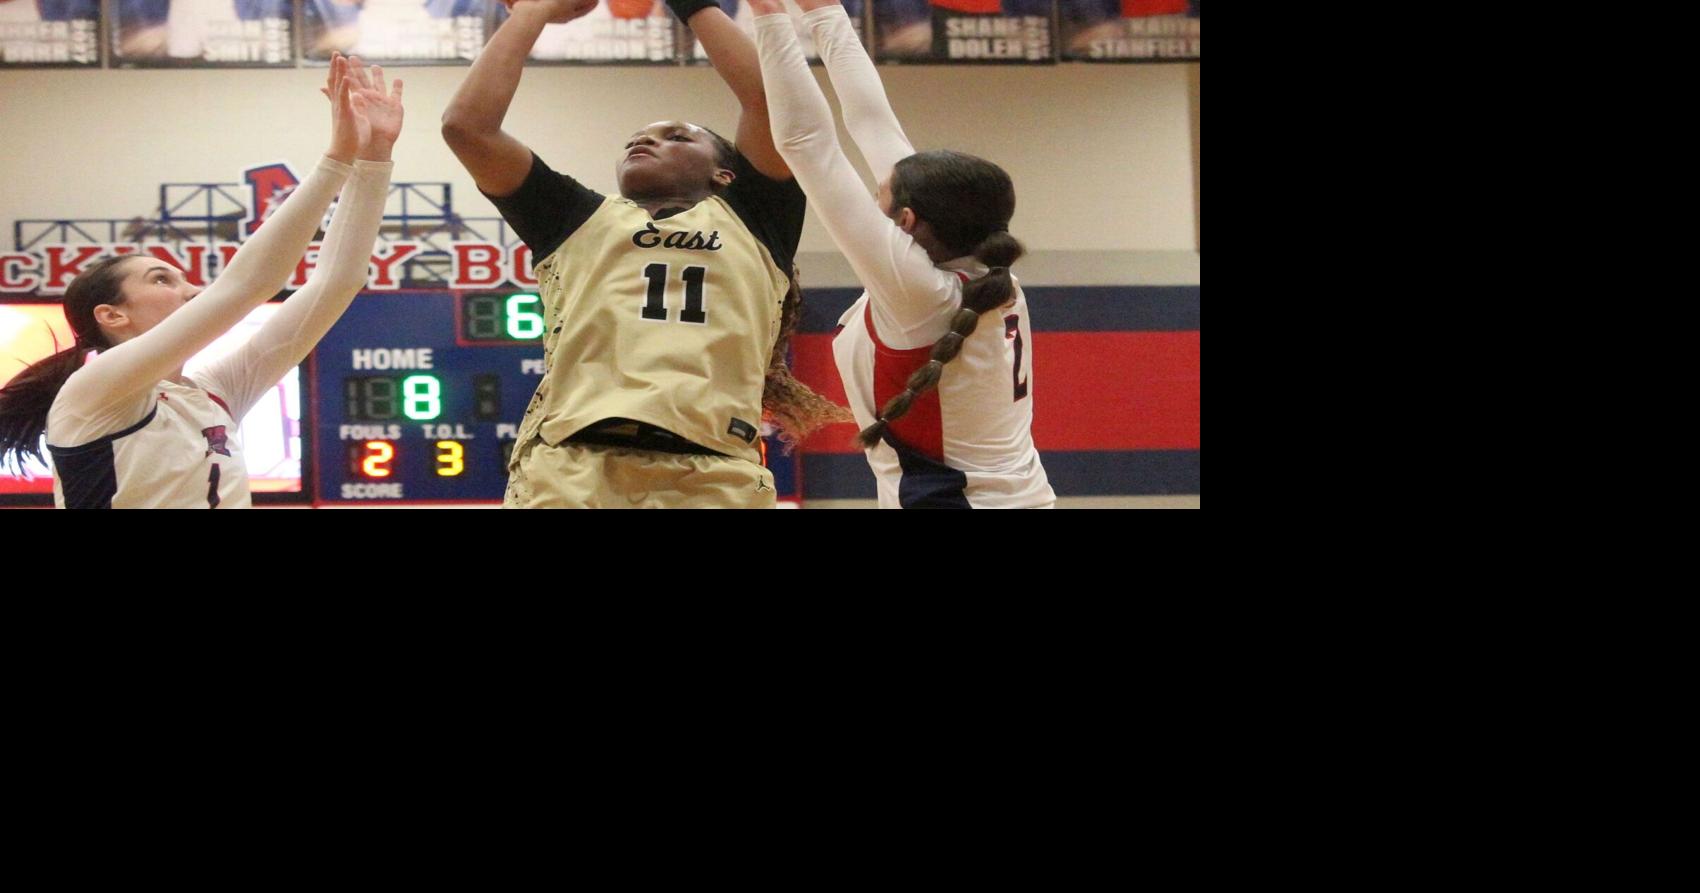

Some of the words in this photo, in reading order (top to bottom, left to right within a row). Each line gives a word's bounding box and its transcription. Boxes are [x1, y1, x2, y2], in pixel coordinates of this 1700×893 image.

[632, 222, 722, 251] East
[641, 262, 706, 324] 11
[506, 294, 544, 339] 6
[352, 349, 434, 370] HOME
[1003, 314, 1028, 402] 2
[403, 375, 441, 420] 8
[339, 424, 402, 440] FOULS
[421, 424, 475, 440] T.O.L.
[362, 440, 394, 477] 2
[436, 440, 464, 477] 3
[207, 463, 221, 509] 1
[341, 483, 403, 499] SCORE
